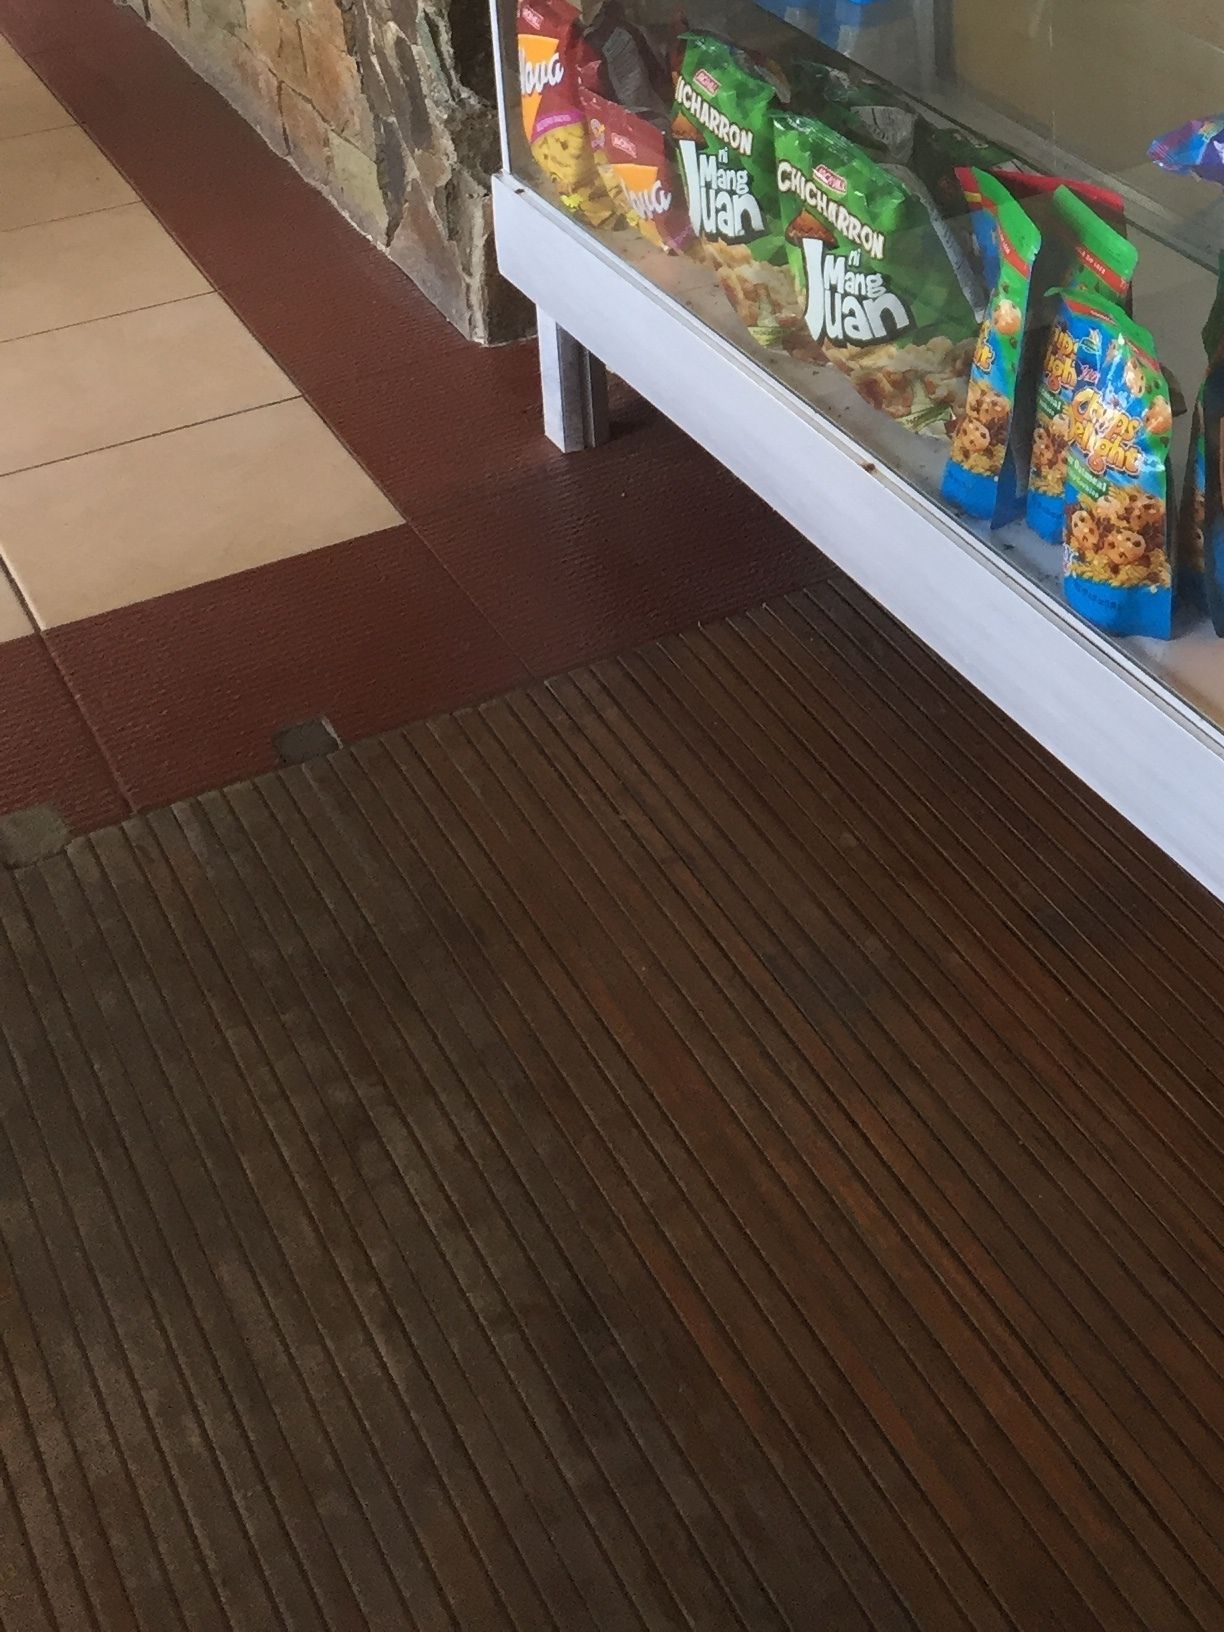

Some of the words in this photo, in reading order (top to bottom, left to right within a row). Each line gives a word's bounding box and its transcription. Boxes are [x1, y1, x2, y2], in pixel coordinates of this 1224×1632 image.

[676, 76, 754, 156] ICHARRON
[700, 153, 749, 195] Mang
[718, 147, 729, 164] ni
[679, 139, 766, 237] Juan
[776, 161, 885, 260] CHICHARRON
[823, 254, 886, 297] Mang
[848, 248, 861, 267] ni
[804, 237, 910, 341] Juan
